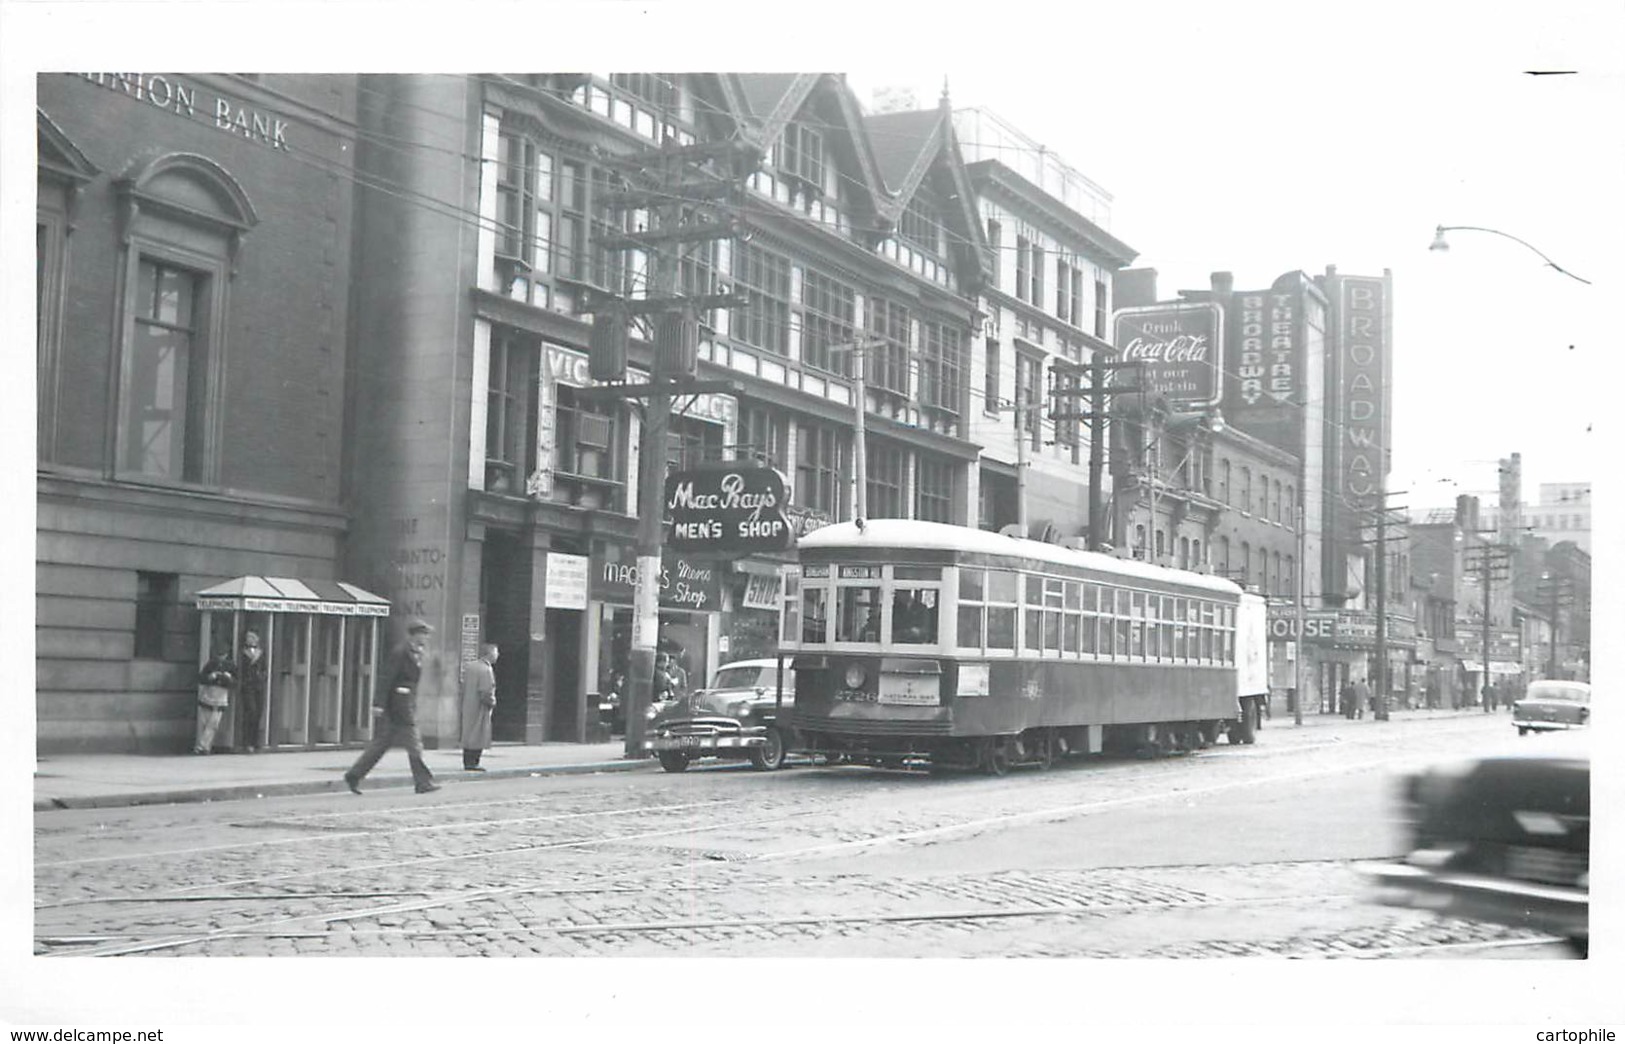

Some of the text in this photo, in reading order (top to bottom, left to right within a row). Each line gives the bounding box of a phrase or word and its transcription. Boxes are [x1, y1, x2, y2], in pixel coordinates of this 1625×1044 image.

[79, 73, 289, 151] NION BANK
[1142, 319, 1182, 334] Drink
[1122, 335, 1208, 363] Coca-Cola
[1271, 294, 1293, 391] THEATRE
[1350, 287, 1375, 500] BROADWAY
[675, 519, 723, 539] MEN'S
[738, 520, 784, 538] SHOP
[671, 582, 707, 609] Shop
[199, 601, 235, 609] TELEPHONE
[247, 601, 283, 610] TELEPHONE
[286, 603, 319, 611] TELEPHONE
[323, 605, 354, 613] TELEPHONE
[358, 606, 388, 615] TELEPHONE
